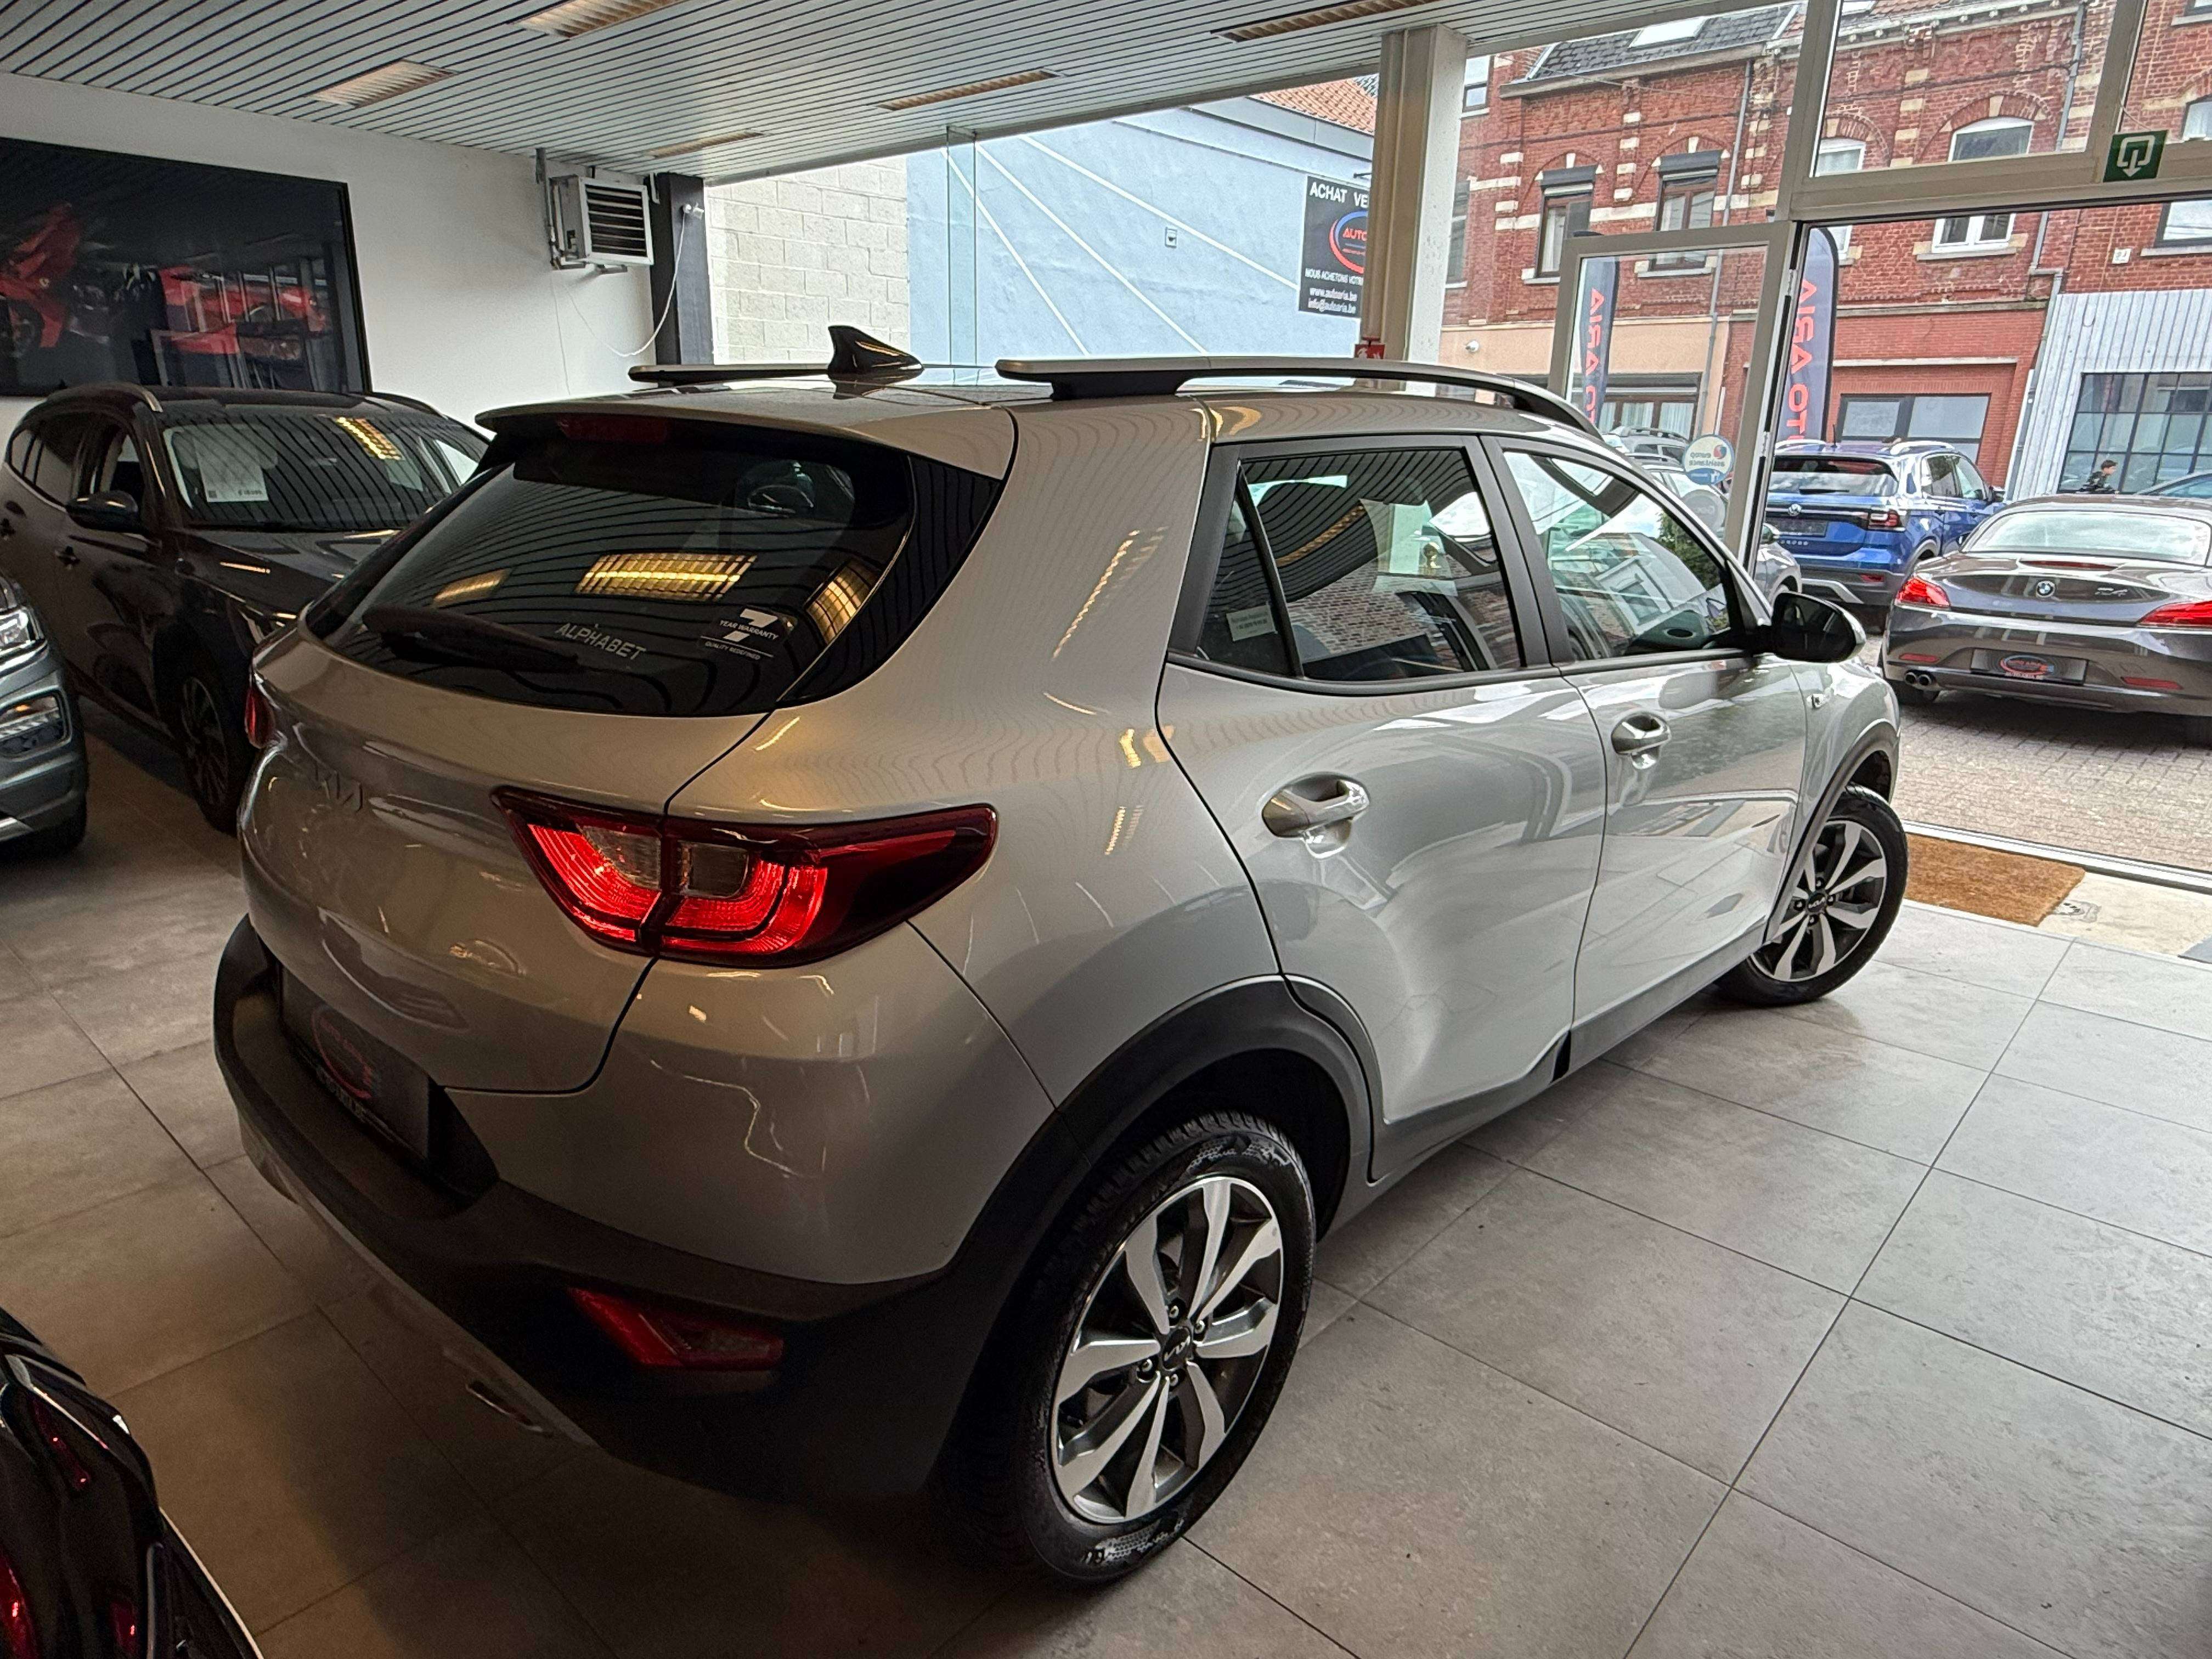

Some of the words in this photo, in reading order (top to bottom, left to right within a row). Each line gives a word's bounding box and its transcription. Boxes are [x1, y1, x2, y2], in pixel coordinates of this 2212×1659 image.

[1310, 182, 1347, 203] ACHAT
[1353, 192, 1369, 208] VE
[555, 623, 646, 660] ALPHABET
[720, 620, 738, 629] YEAR
[738, 624, 779, 640] WARRANTY
